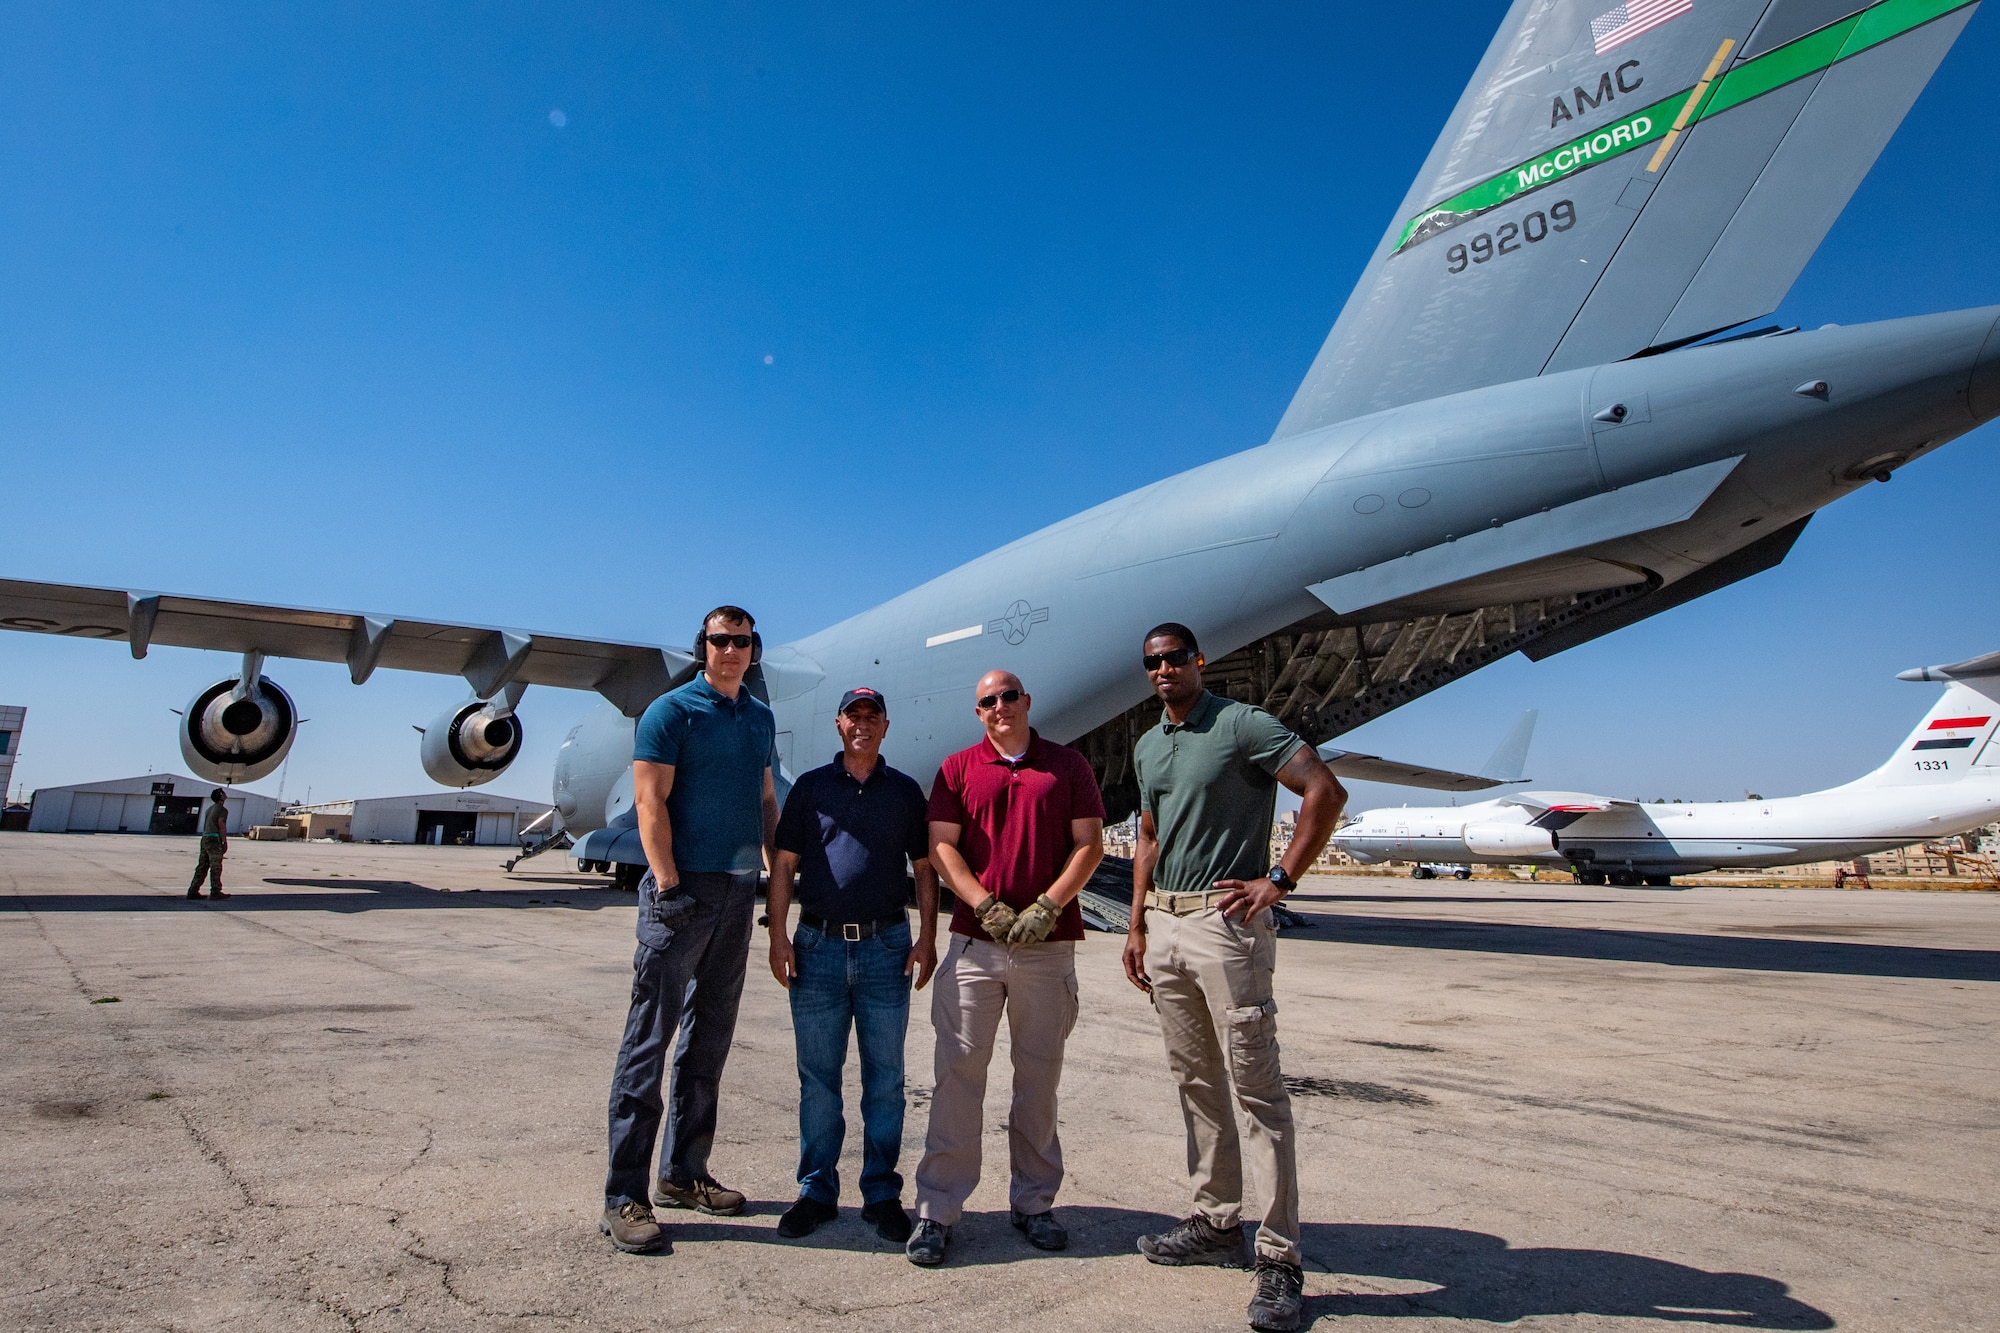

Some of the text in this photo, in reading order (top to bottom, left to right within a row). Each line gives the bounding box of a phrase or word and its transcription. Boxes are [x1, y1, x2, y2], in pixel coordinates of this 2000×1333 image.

[1551, 59, 1644, 129] AMC
[1517, 116, 1653, 188] McCHORD
[1446, 199, 1577, 274] 99209
[1914, 760, 1949, 771] 1331
